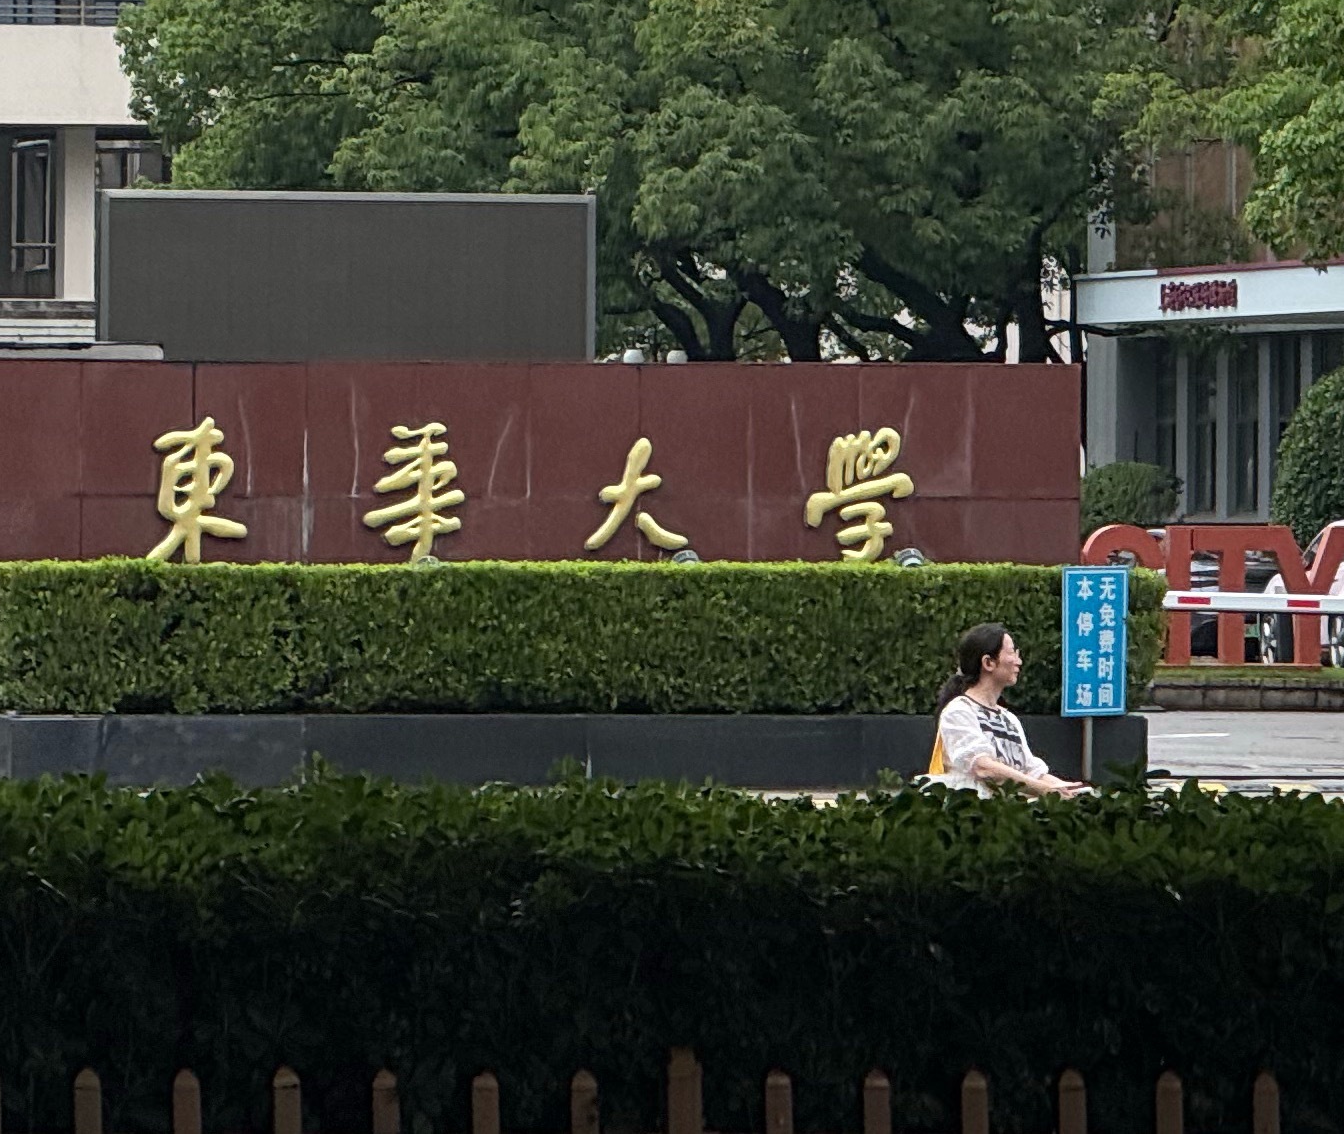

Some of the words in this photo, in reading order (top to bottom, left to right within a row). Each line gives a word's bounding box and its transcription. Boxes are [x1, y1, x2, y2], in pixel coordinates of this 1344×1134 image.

[148, 416, 914, 564] 東華大學
[1076, 575, 1094, 707] 本停车场
[1097, 576, 1117, 706] 无免费时间
